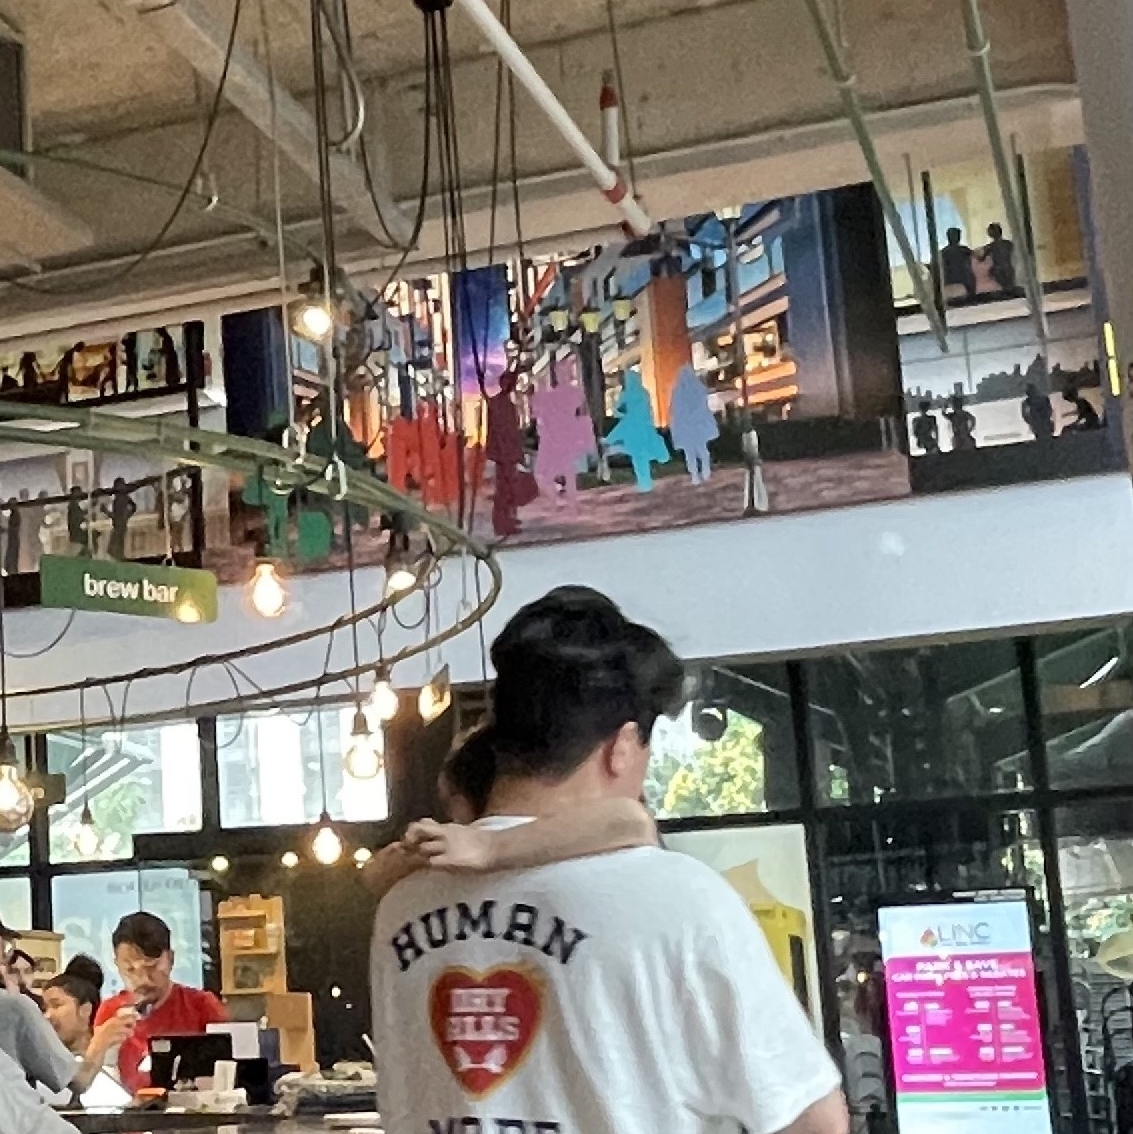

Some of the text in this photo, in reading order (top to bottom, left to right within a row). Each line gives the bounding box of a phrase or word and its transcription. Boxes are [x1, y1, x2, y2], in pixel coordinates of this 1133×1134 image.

[84, 573, 178, 603] brew bar
[390, 900, 588, 971] HUMAN
[937, 922, 990, 942] LINC
